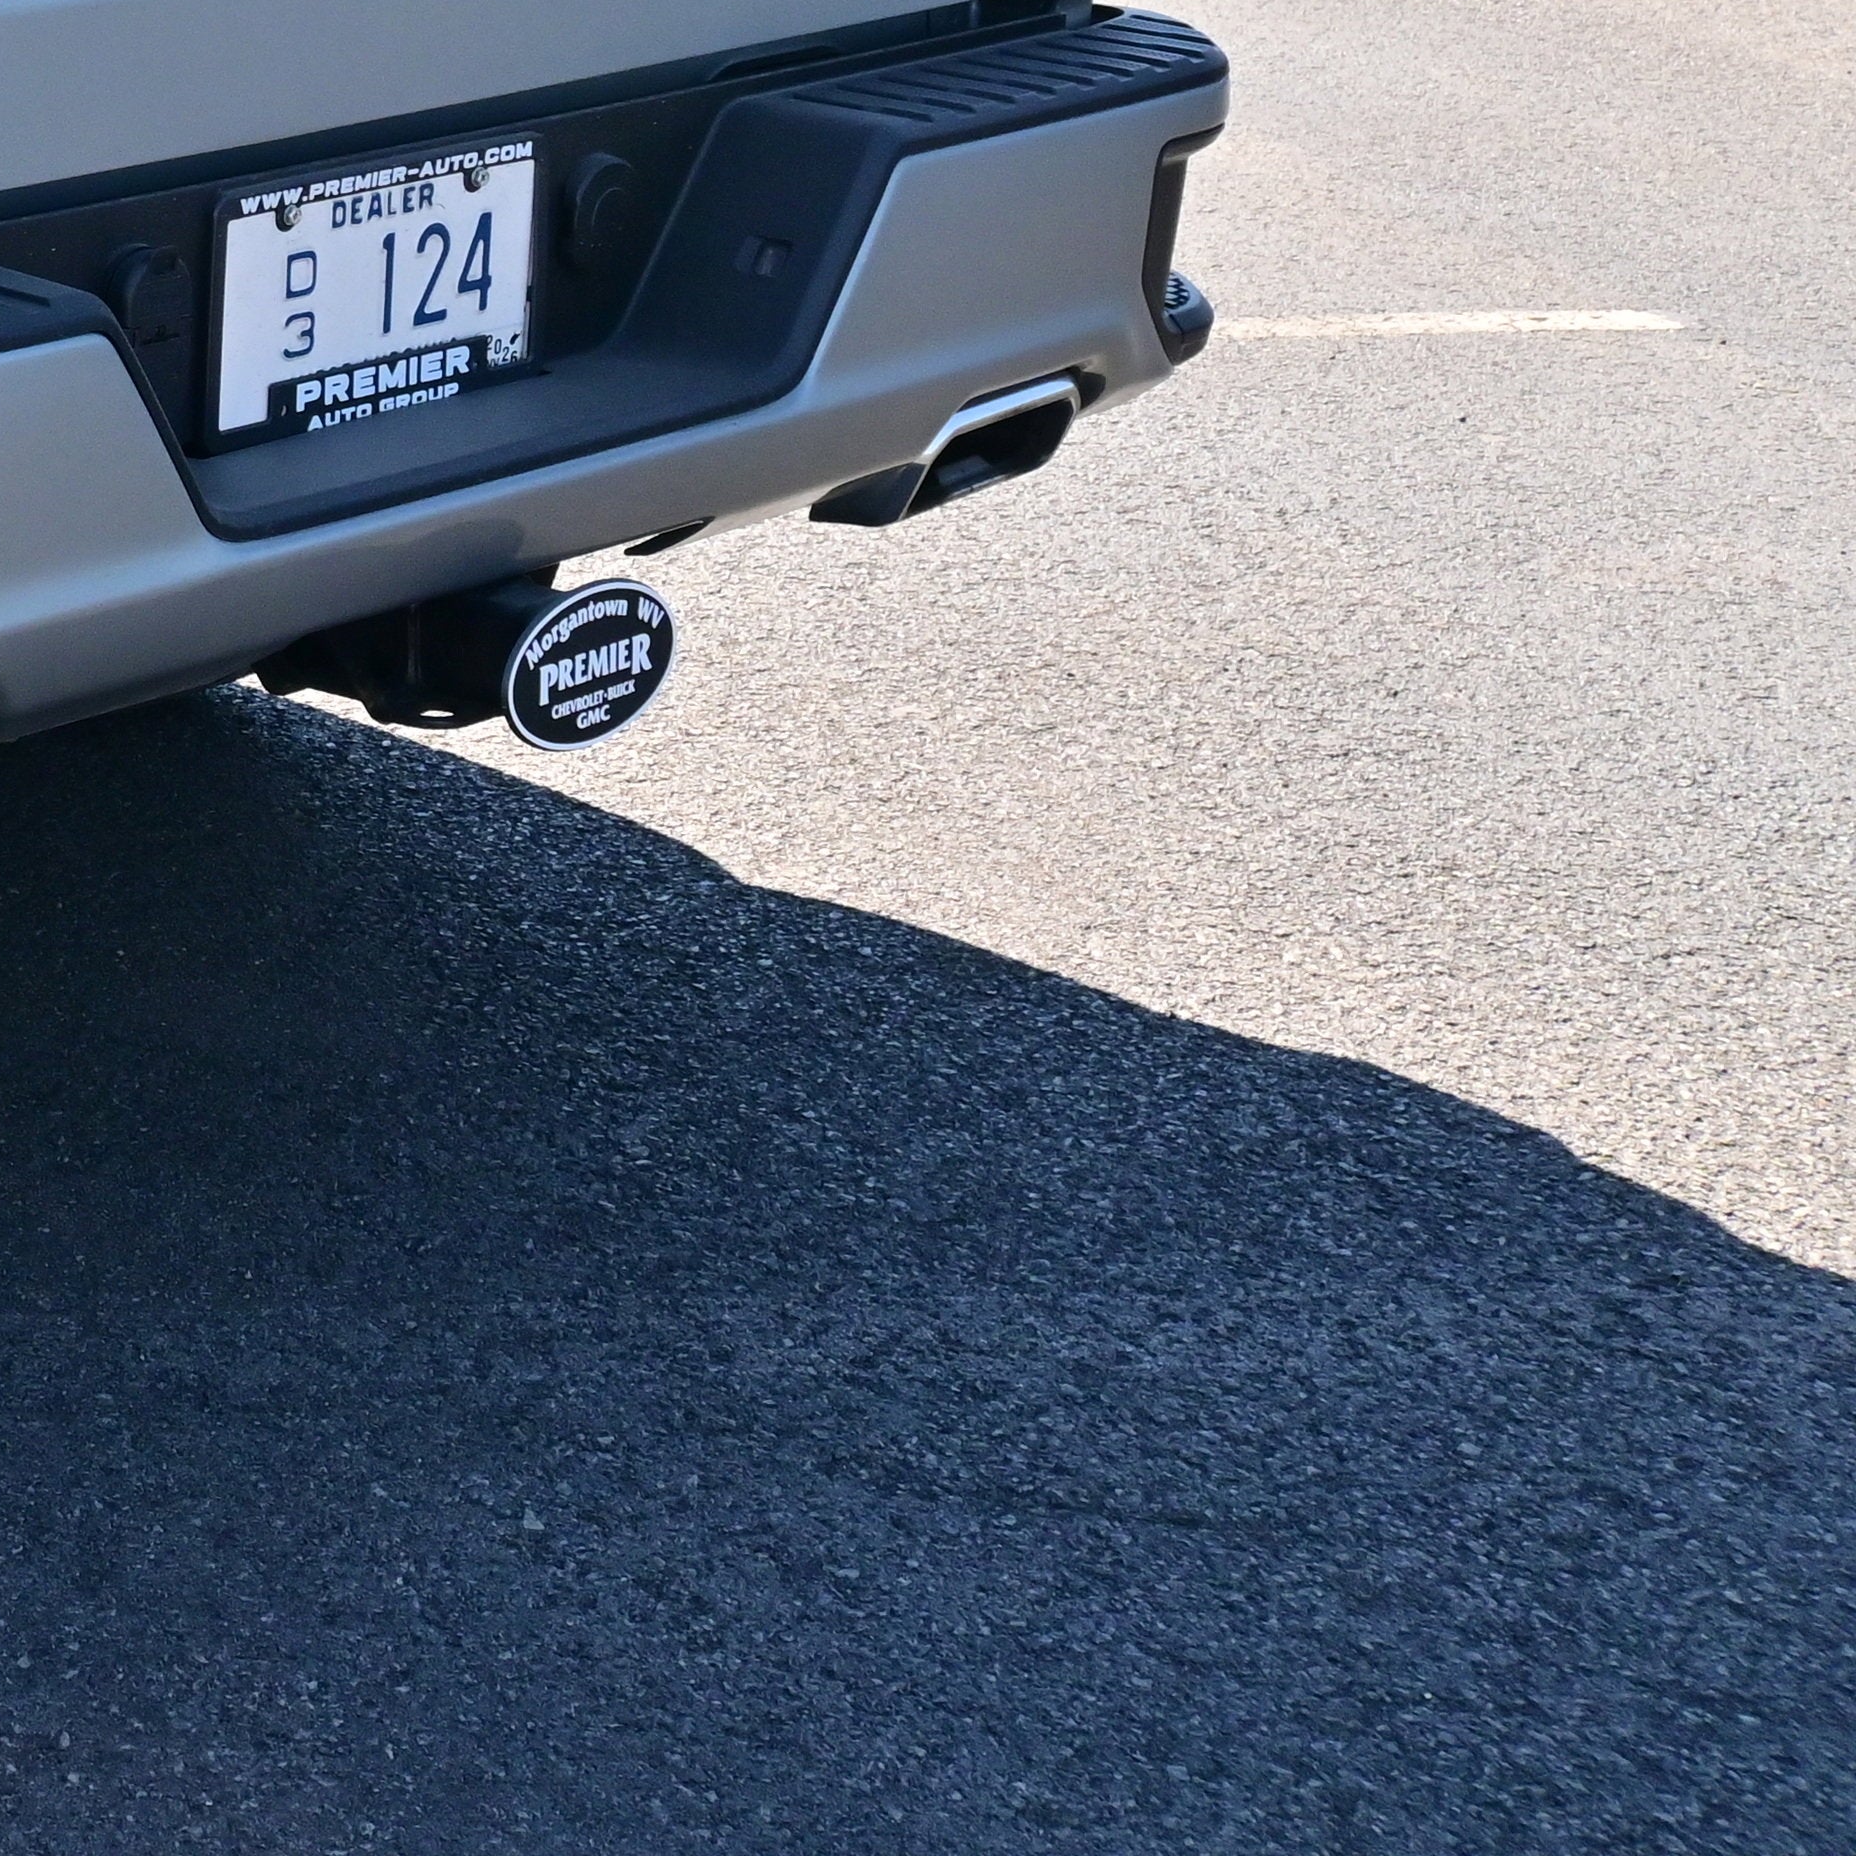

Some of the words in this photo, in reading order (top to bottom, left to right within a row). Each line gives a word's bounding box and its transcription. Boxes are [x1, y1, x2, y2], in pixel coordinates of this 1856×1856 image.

[240, 140, 534, 216] WWW.PREMIER-AUTO.COM
[331, 182, 435, 230] DEALER
[382, 211, 493, 336] 124
[282, 310, 315, 361] 3
[295, 344, 471, 413] PREMIER
[307, 402, 373, 433] AUTO
[378, 381, 460, 413] GROUP
[524, 598, 629, 671] Morgantown
[637, 596, 665, 630] WV
[539, 632, 653, 707] PREMIER
[576, 704, 611, 730] GMC
